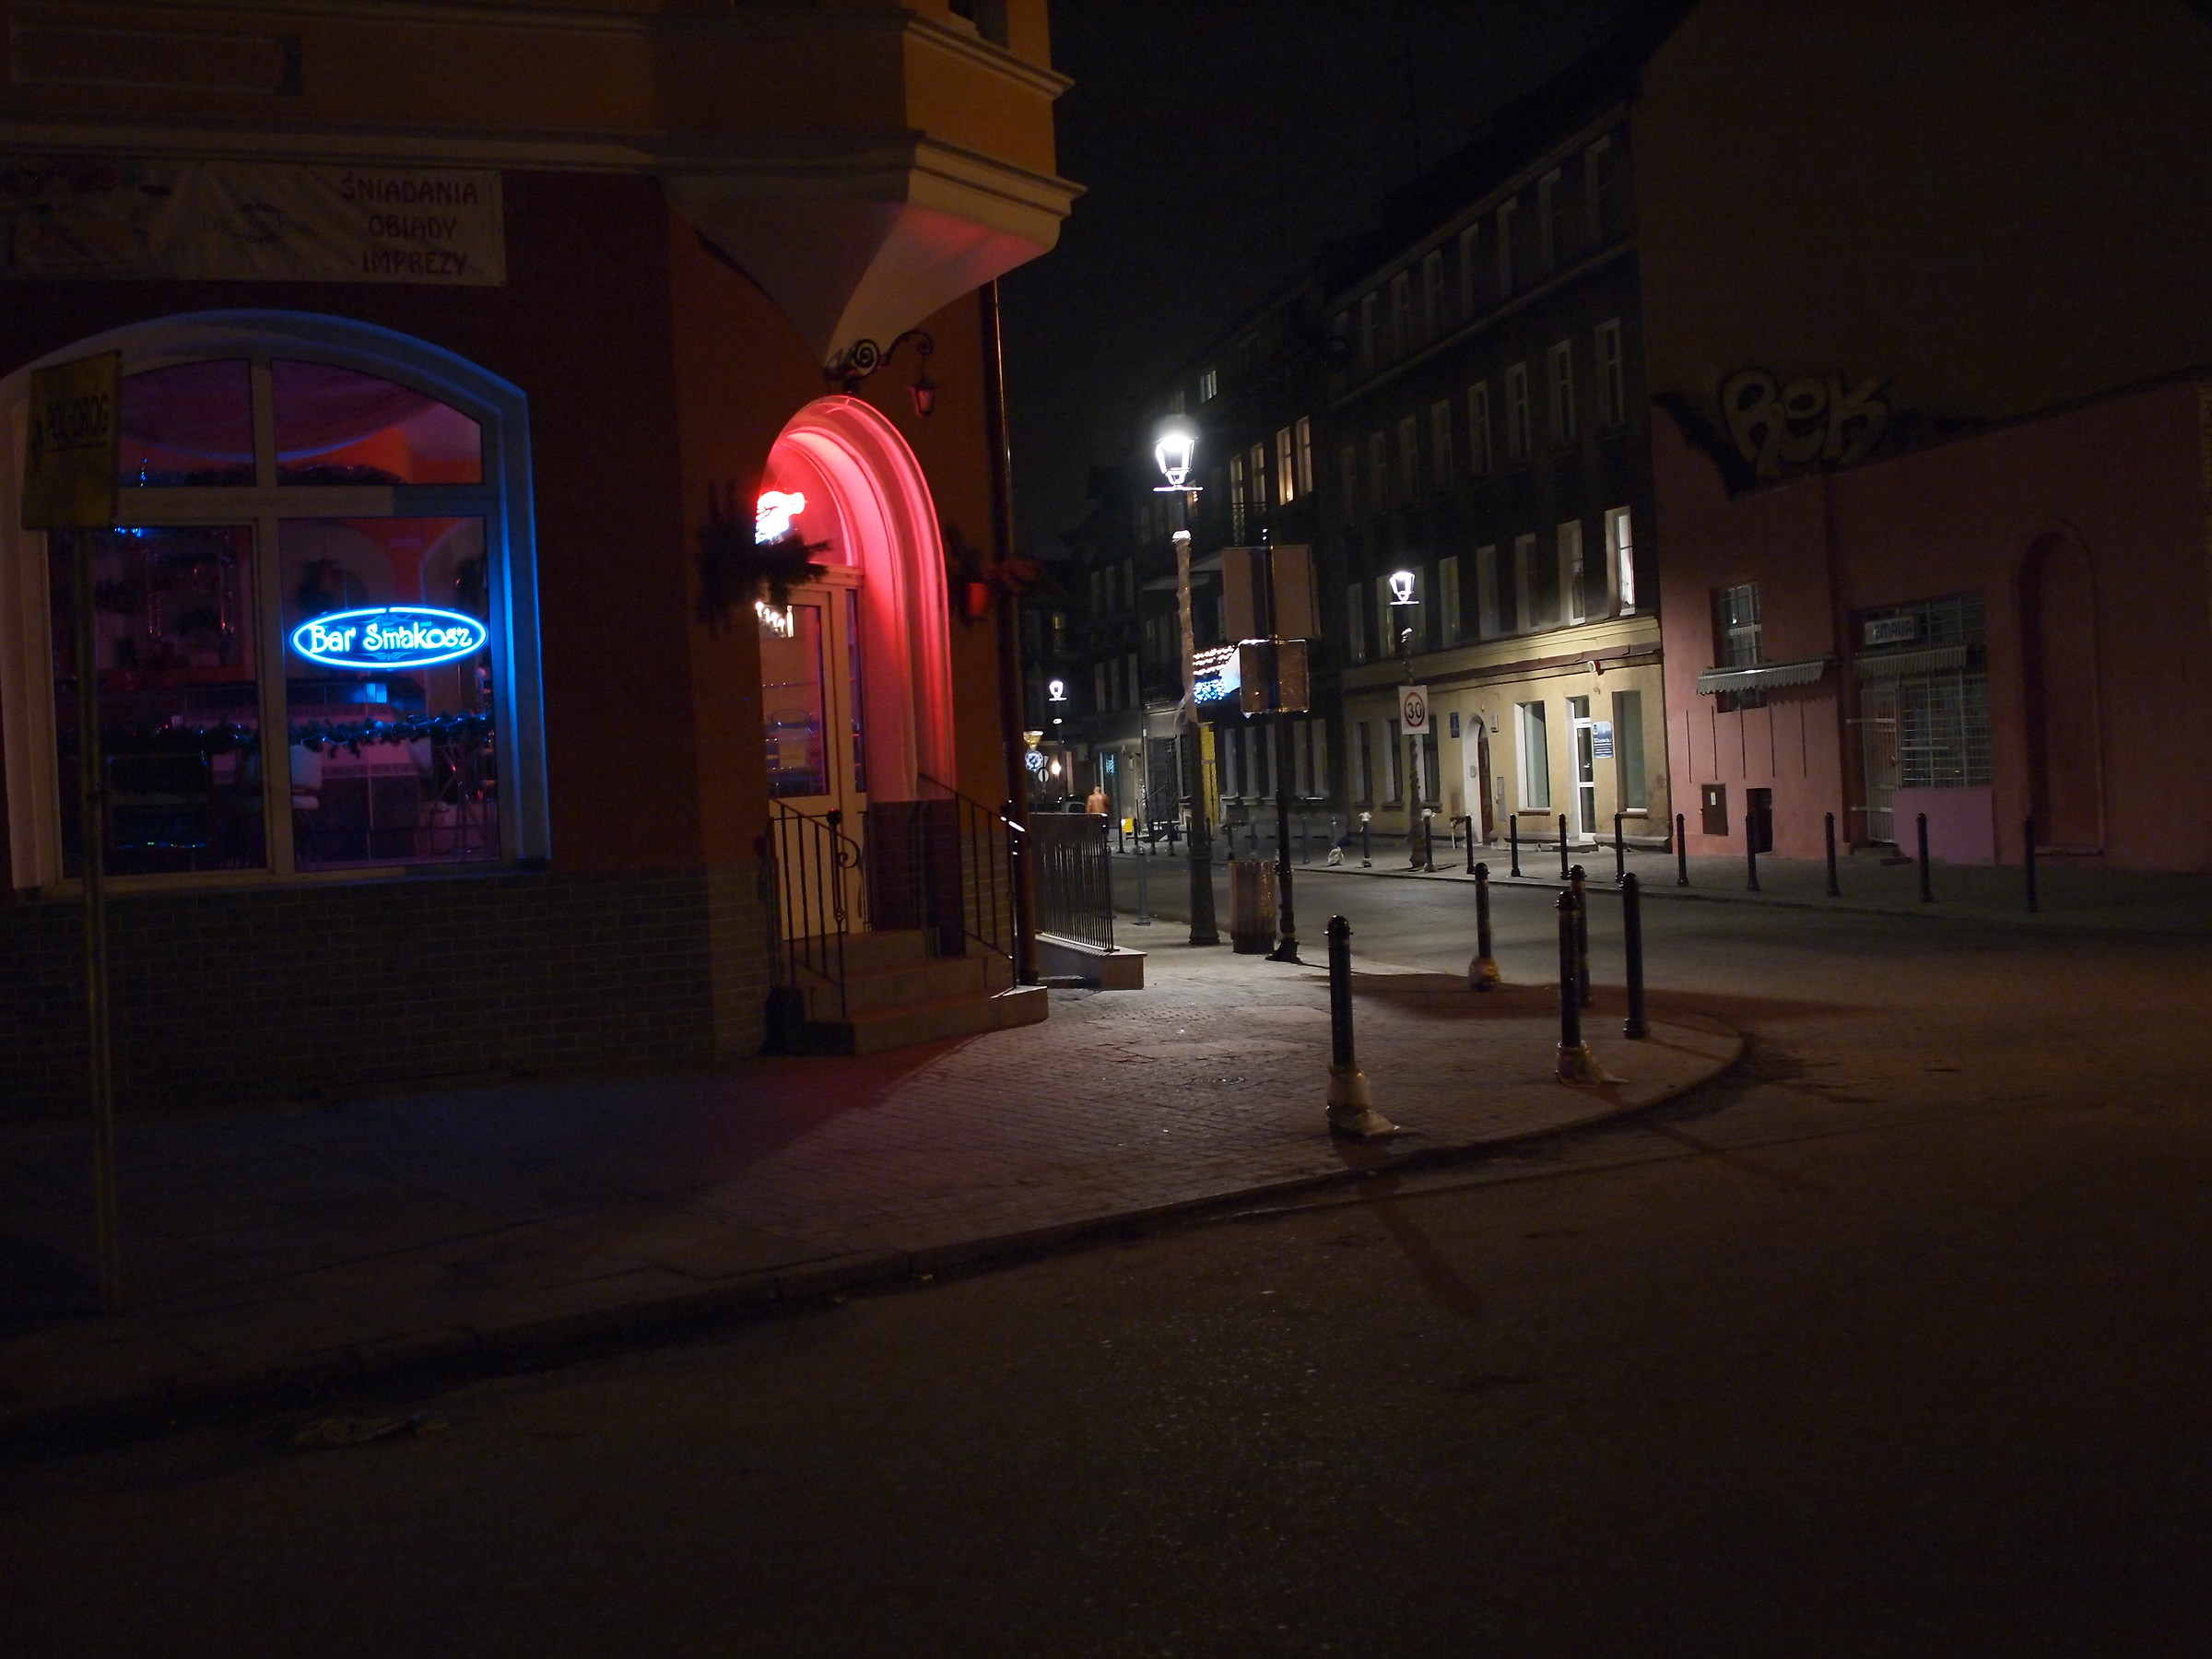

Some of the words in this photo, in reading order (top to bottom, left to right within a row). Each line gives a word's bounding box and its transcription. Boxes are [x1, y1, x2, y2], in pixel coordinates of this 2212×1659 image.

[341, 171, 478, 205] ŚNIADANIA
[368, 214, 457, 240] OBIADY
[362, 249, 468, 276] IMPREZY
[308, 624, 357, 653] Bar
[362, 620, 474, 651] Smakosz
[1406, 701, 1422, 719] 30
